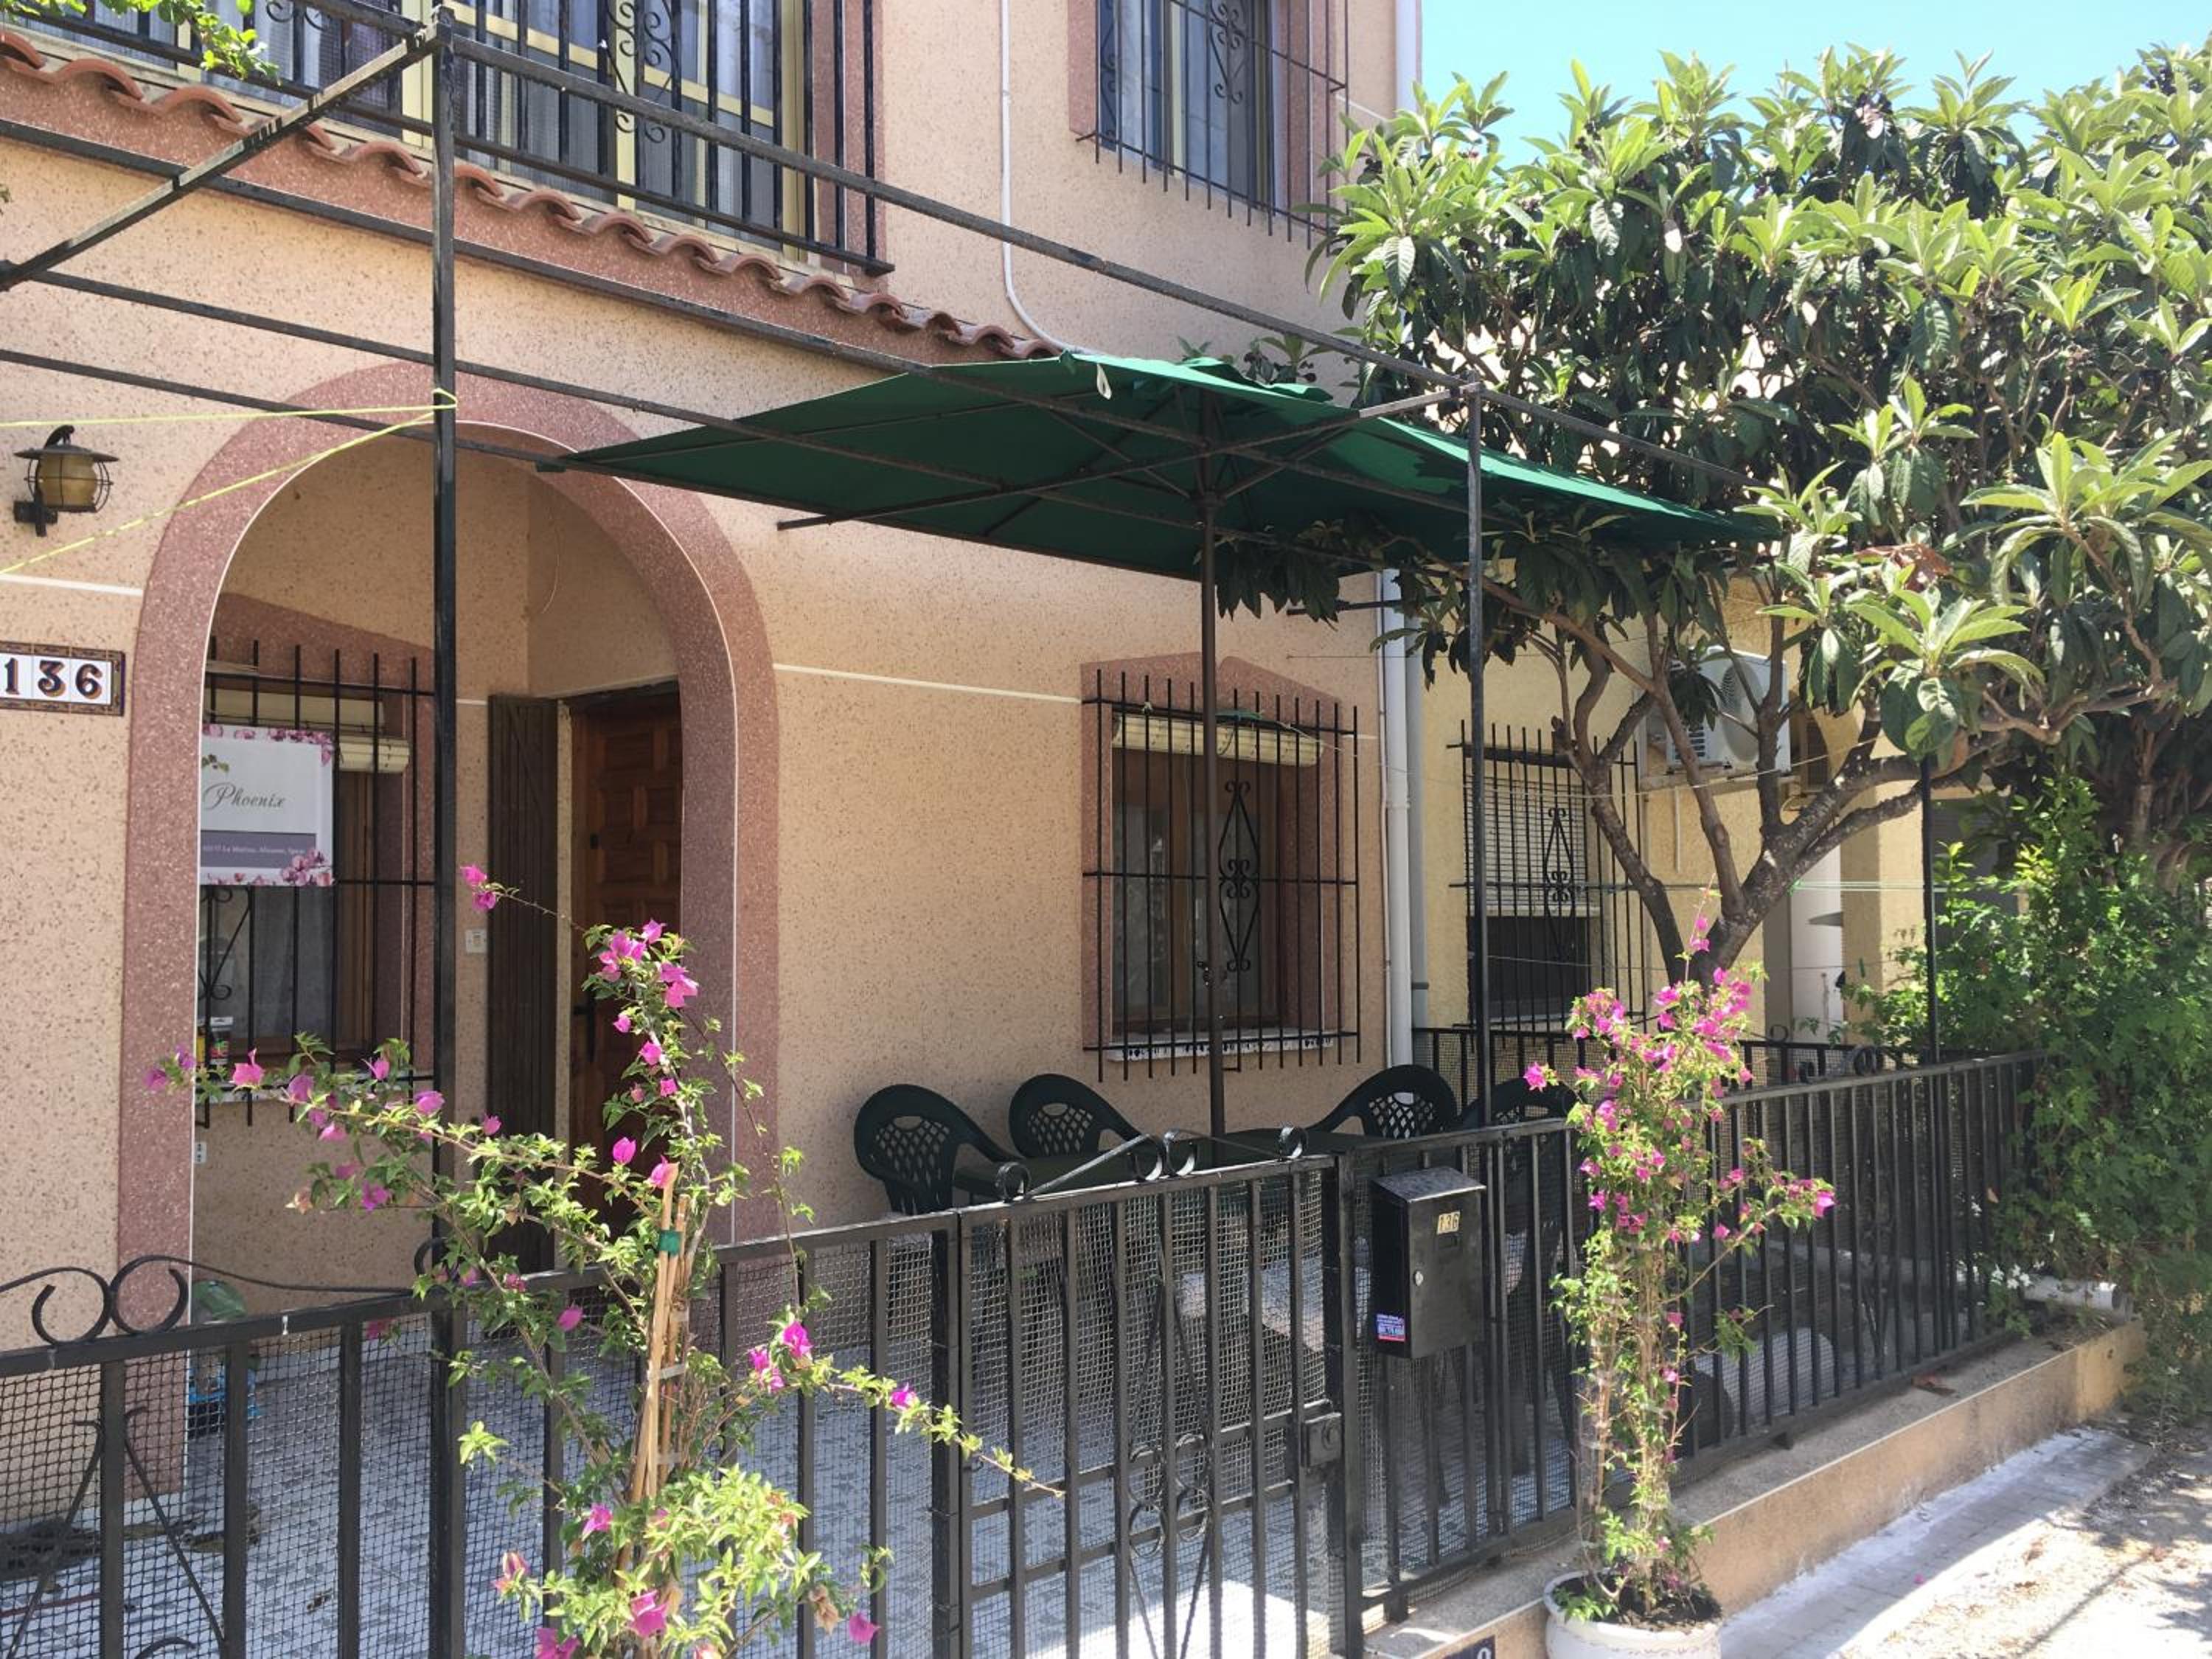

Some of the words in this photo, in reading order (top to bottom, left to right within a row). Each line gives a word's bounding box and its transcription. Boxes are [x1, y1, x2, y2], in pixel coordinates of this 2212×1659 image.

[4, 658, 103, 699] 136
[202, 782, 286, 810] Phoenix
[1439, 1213, 1459, 1230] 136
